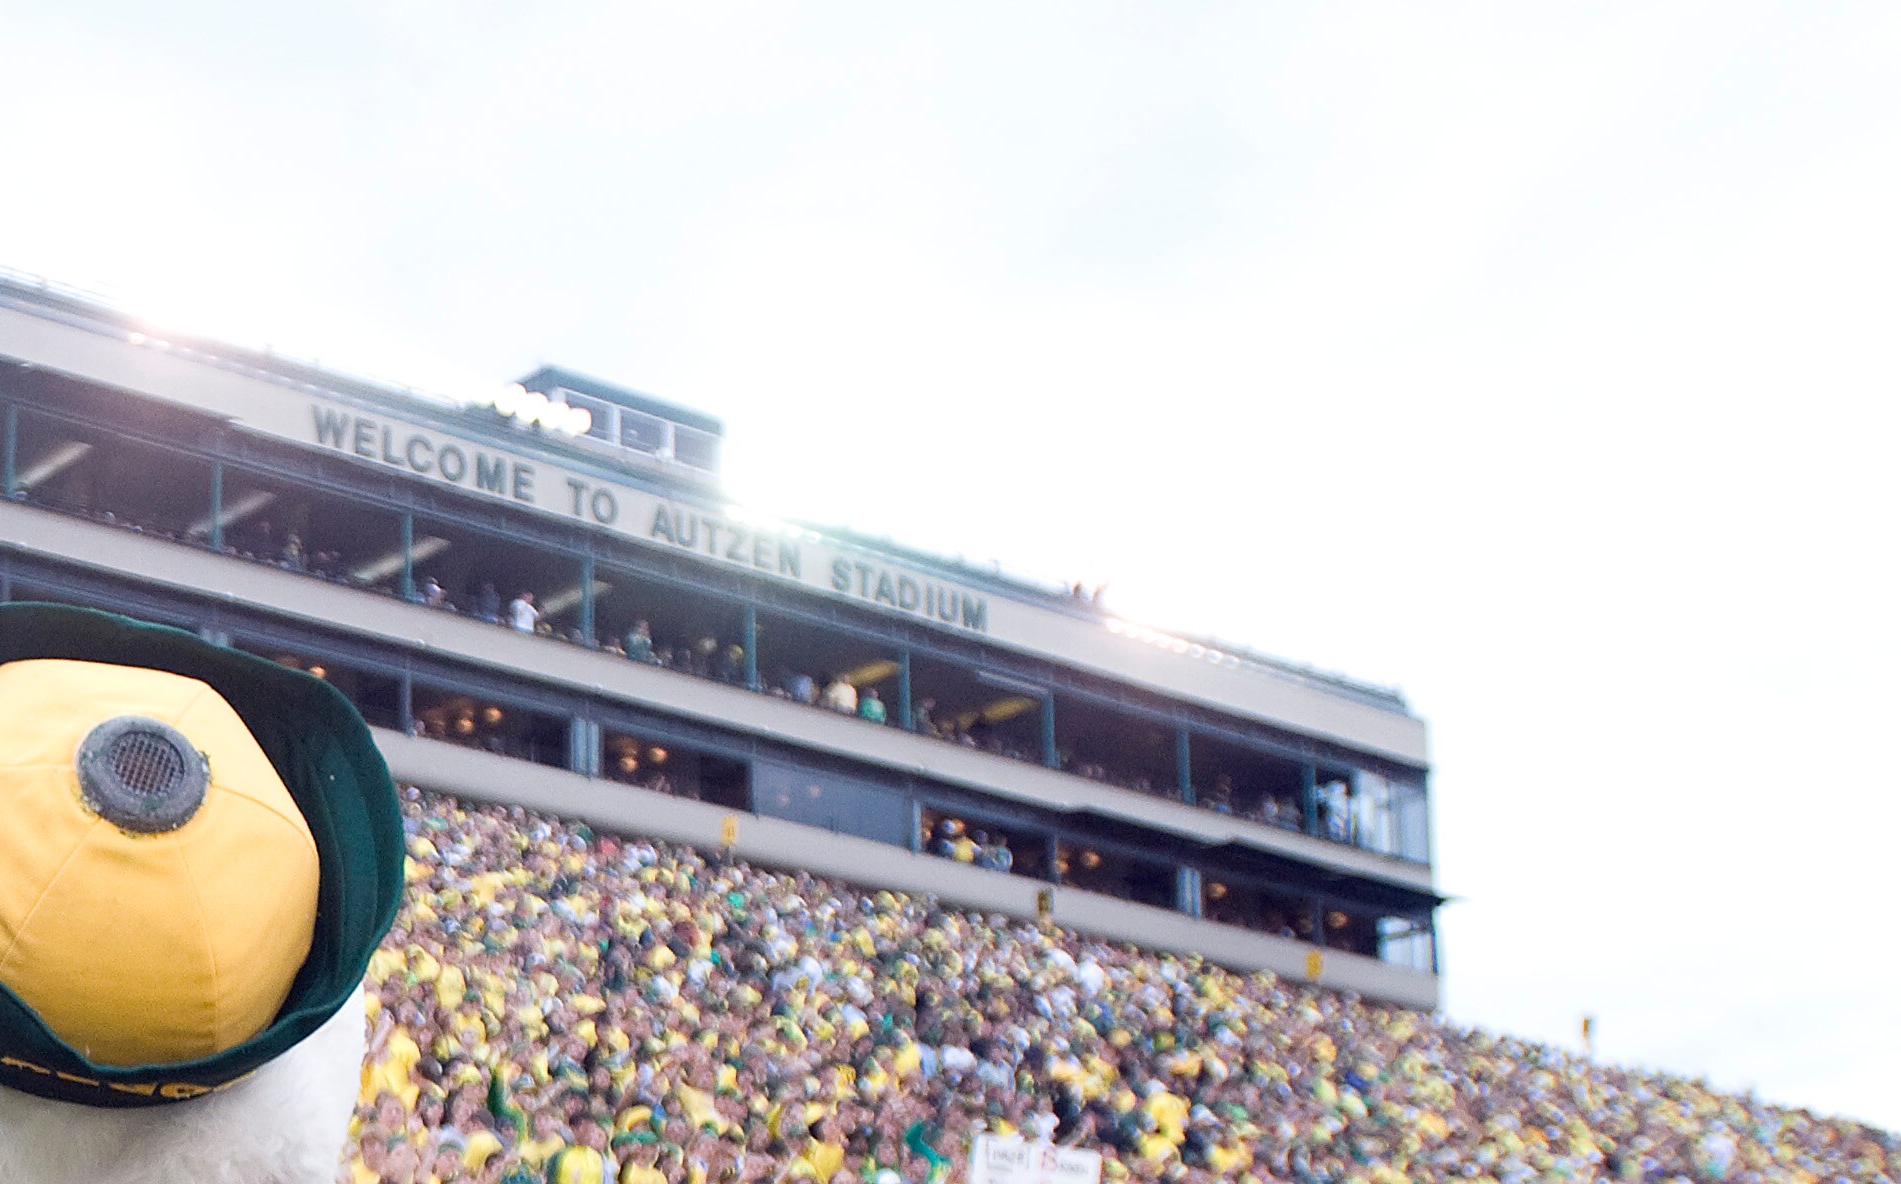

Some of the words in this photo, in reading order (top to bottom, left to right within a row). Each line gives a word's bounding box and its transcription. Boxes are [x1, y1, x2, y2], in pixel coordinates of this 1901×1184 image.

[311, 404, 537, 502] WELCOME
[565, 476, 619, 525] TO
[651, 502, 803, 578] AUTZEN
[831, 555, 989, 633] STADIUM
